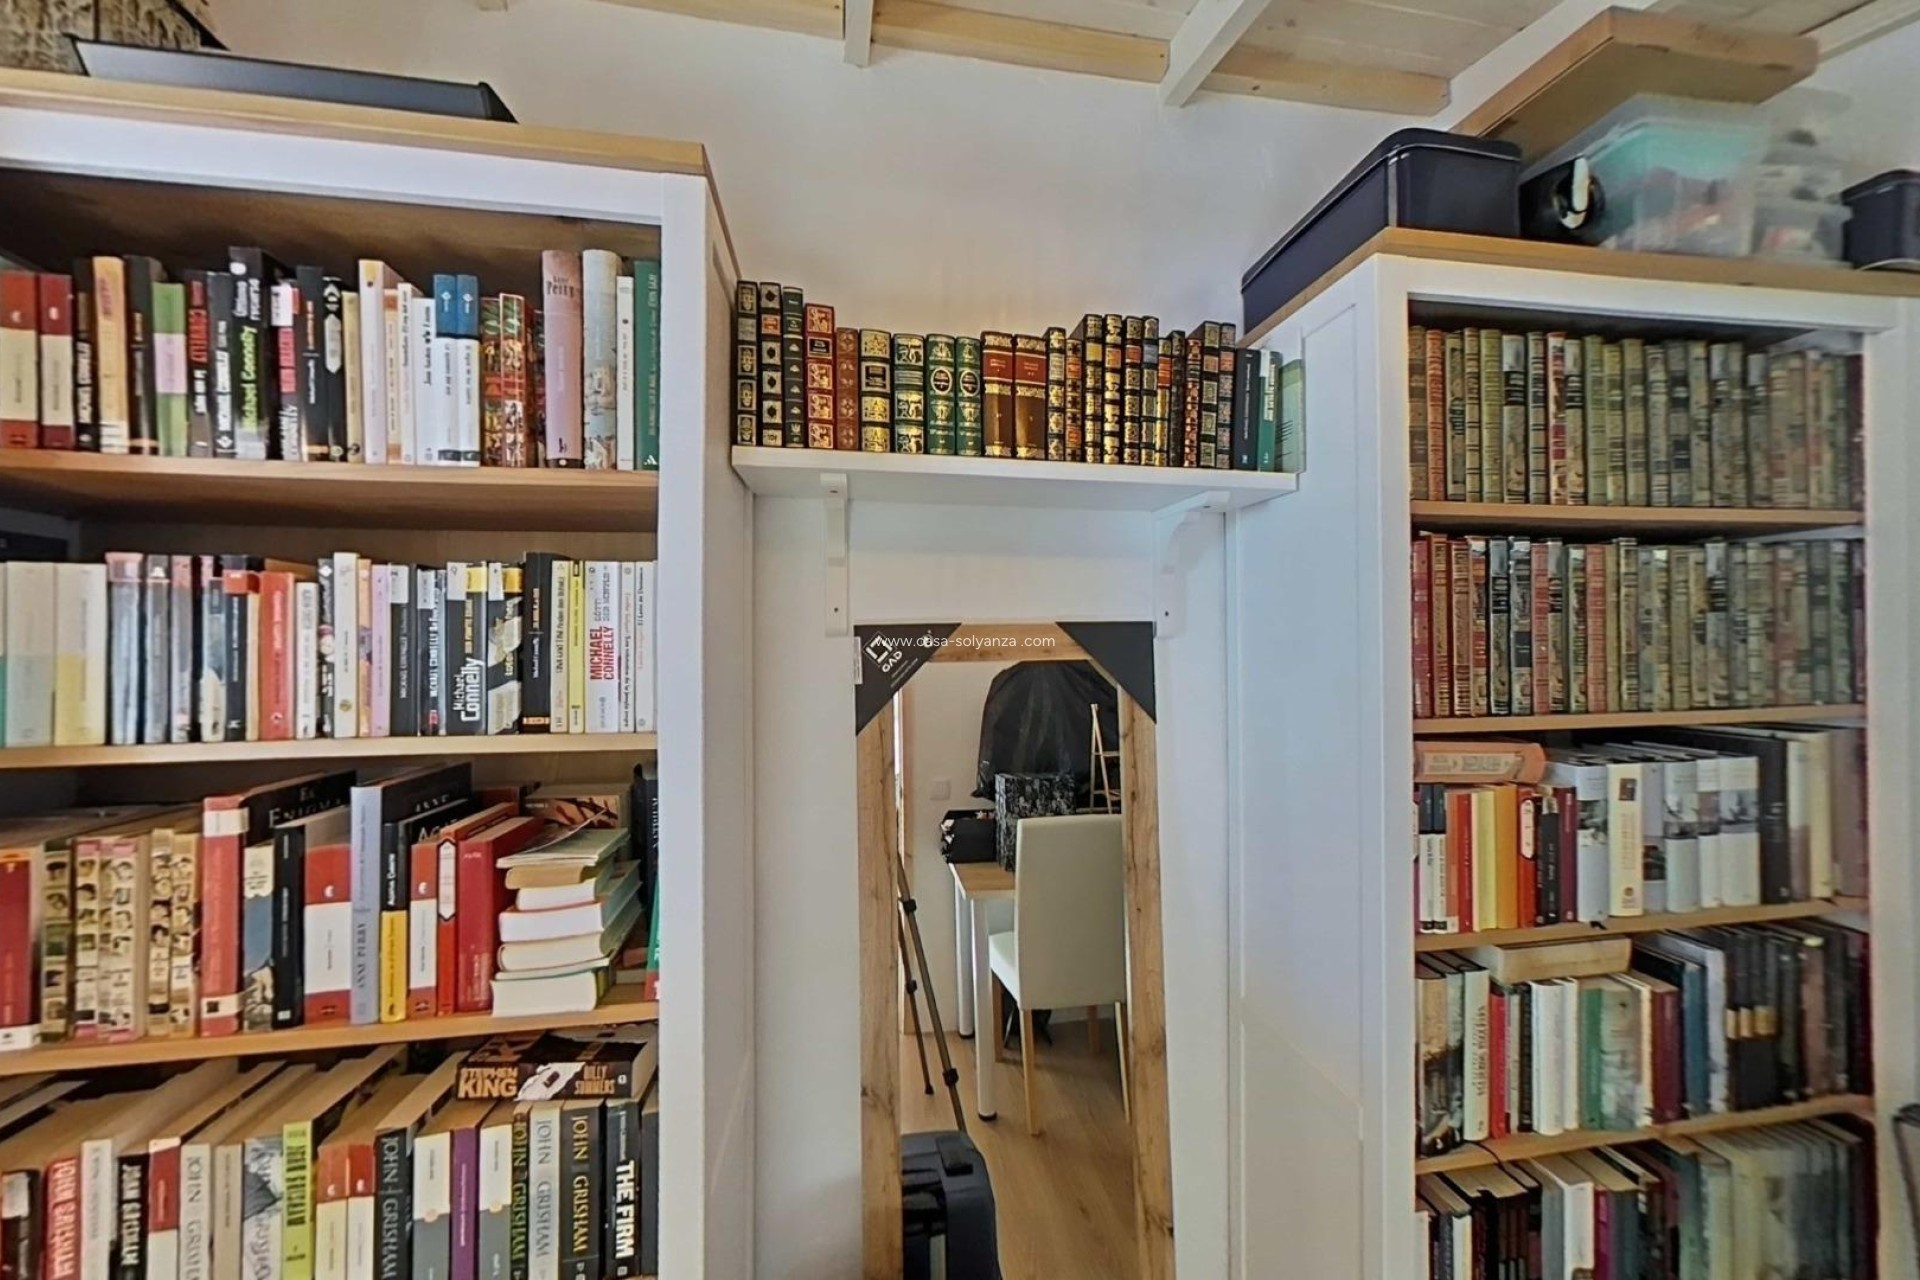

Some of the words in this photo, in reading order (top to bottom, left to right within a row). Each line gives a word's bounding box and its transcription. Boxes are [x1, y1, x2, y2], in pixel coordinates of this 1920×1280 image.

[241, 326, 257, 380] Connelly
[243, 383, 258, 432] Michael
[589, 626, 602, 680] MICHAEL
[602, 626, 615, 680] CONNELLY
[452, 674, 465, 711] Michael
[460, 657, 484, 722] Connelly
[357, 922, 366, 957] PERRY
[457, 1079, 517, 1099] KING
[460, 1067, 518, 1081] STEPHEN
[382, 1137, 399, 1183] JOHN
[513, 1123, 527, 1166] JOHN
[537, 1120, 552, 1164] JOHN
[571, 1115, 589, 1160] JOHN
[54, 1159, 77, 1203] JOHN
[122, 1165, 142, 1200] JOHN
[187, 1156, 202, 1202] JOHN
[615, 1160, 635, 1203] THE
[512, 1182, 527, 1261] GRISHAM
[537, 1181, 552, 1258] GRISHAM
[572, 1175, 589, 1252] GRISHAM
[615, 1204, 635, 1259] FIRM
[382, 1198, 398, 1280] GRISHAM
